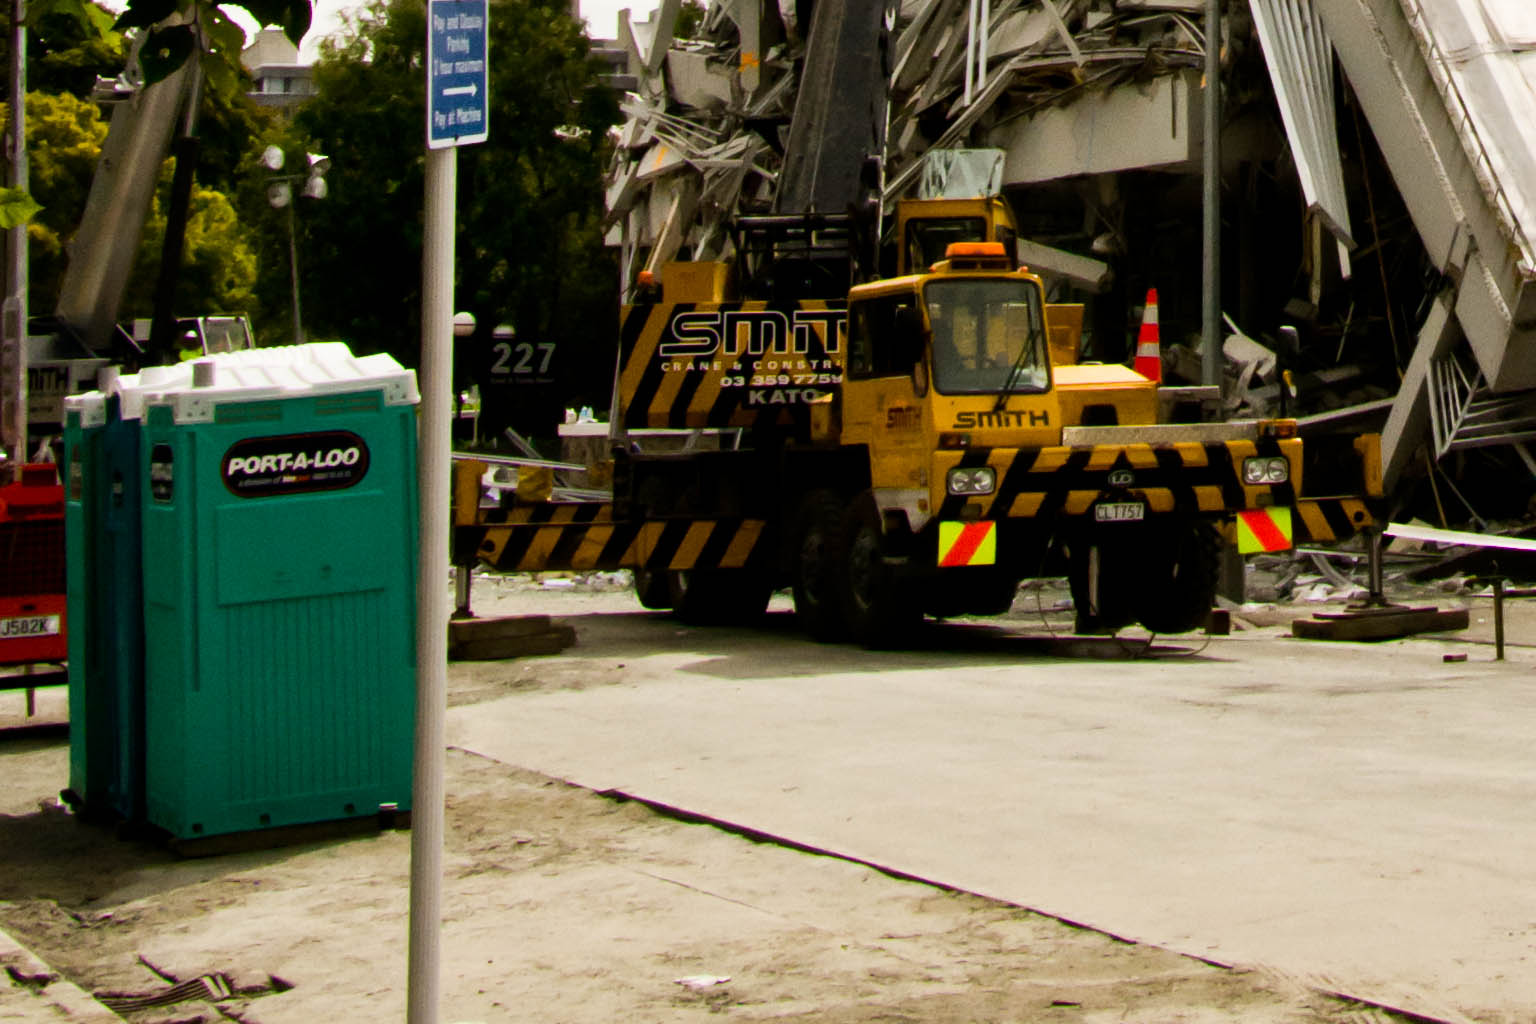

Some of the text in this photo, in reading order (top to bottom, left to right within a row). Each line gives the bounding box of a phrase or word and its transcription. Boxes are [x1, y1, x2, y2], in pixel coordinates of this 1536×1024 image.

[659, 310, 848, 356] SMIT
[491, 342, 556, 373] 227
[661, 360, 722, 372] CRANE
[720, 376, 745, 387] 03
[752, 374, 789, 386] 359
[749, 389, 818, 405] KATO
[227, 446, 360, 476] PORT-A-LOO
